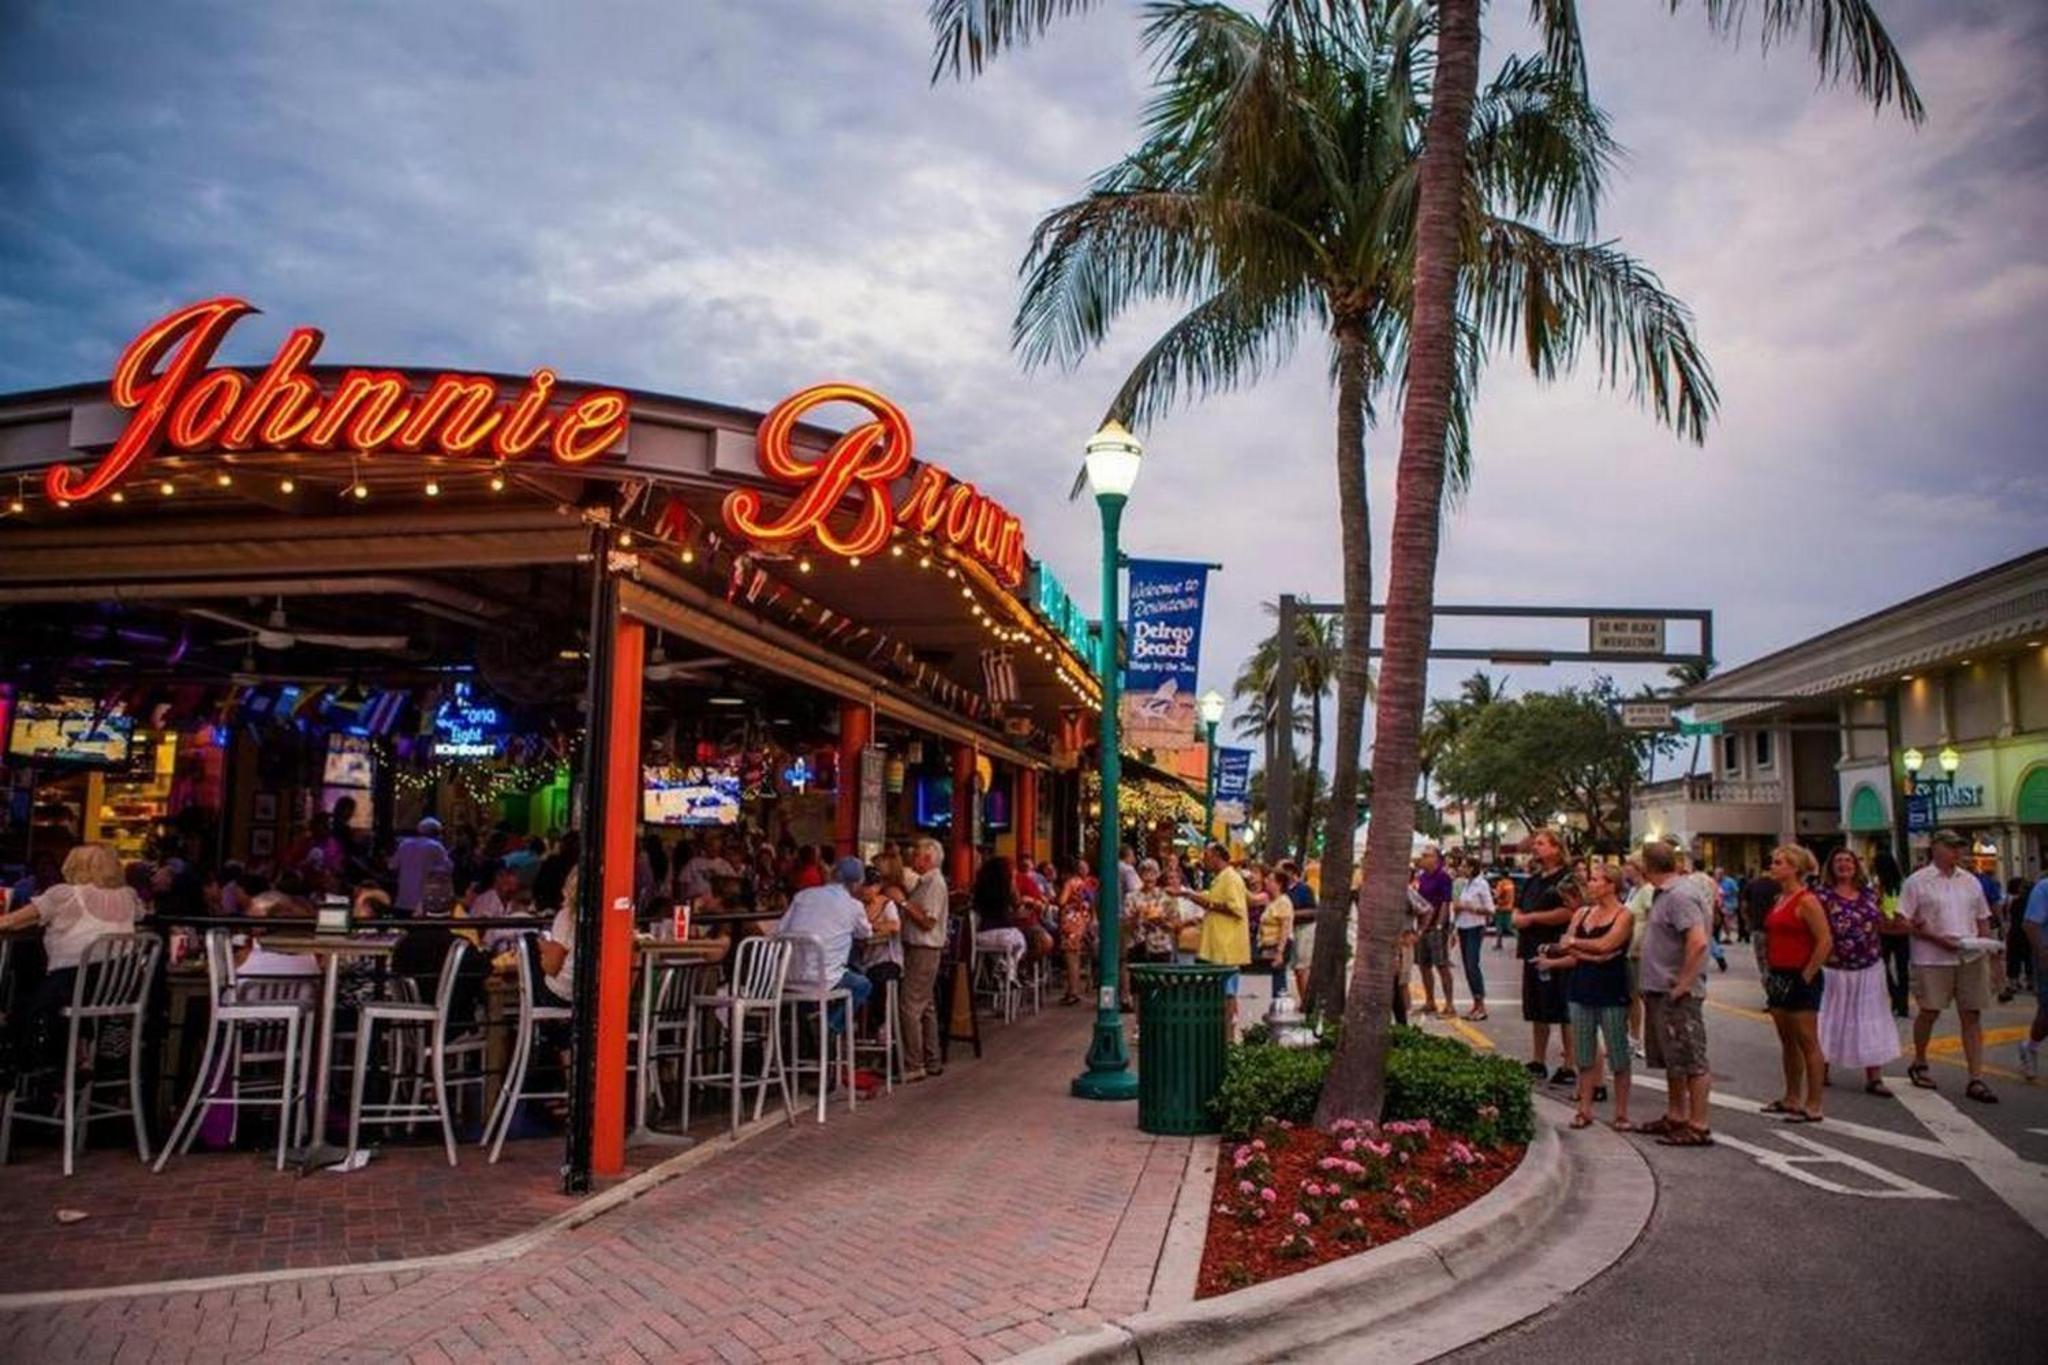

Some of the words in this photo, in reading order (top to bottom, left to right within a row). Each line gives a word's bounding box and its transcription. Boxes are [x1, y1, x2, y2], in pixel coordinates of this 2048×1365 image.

[46, 296, 628, 502] Johnnie
[1134, 621, 1195, 644] Delray
[1132, 639, 1188, 658] Beach
